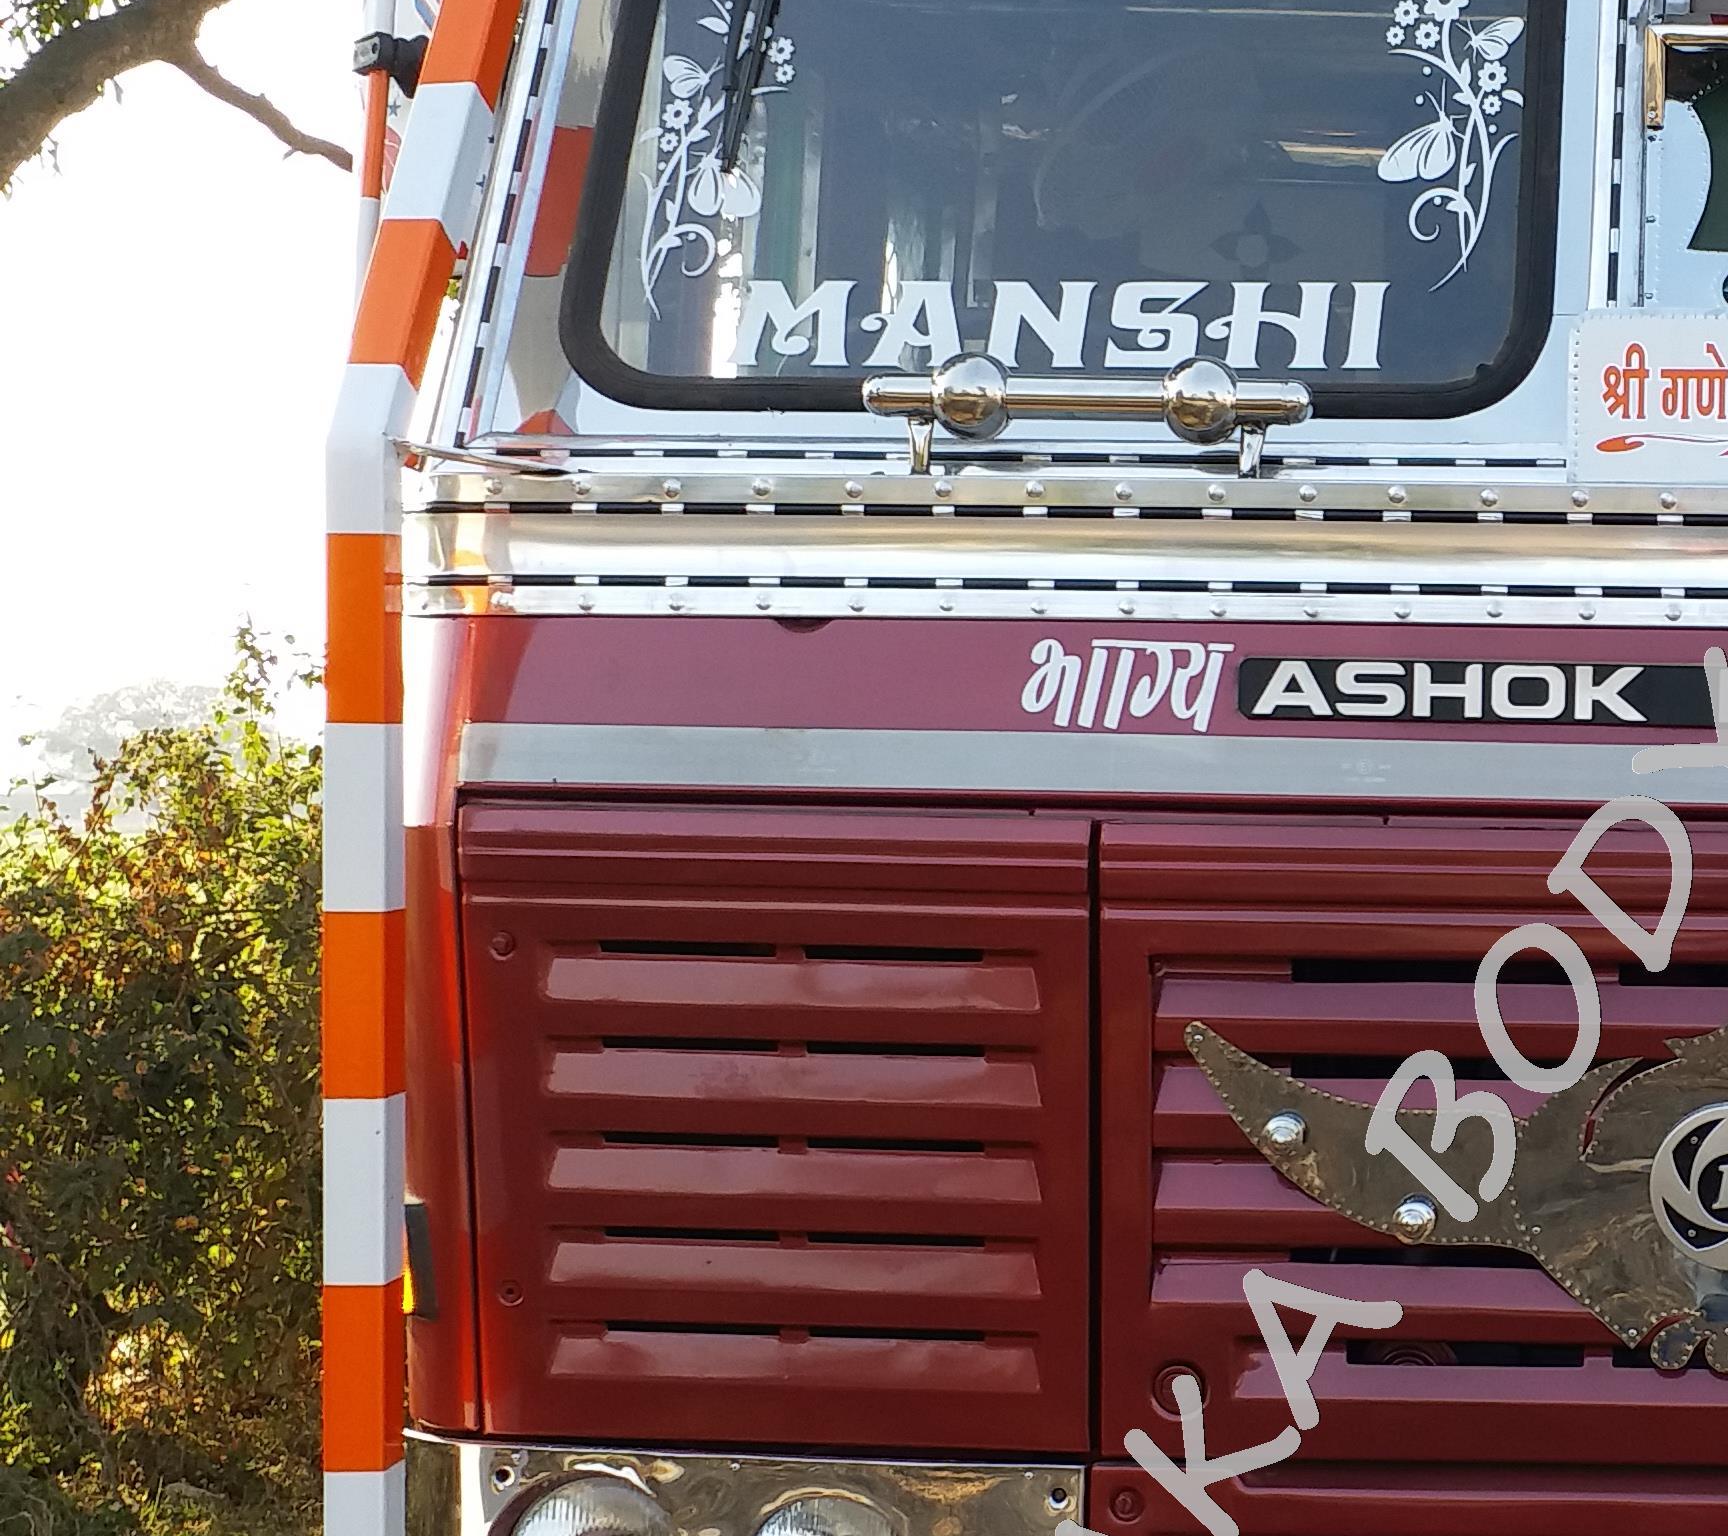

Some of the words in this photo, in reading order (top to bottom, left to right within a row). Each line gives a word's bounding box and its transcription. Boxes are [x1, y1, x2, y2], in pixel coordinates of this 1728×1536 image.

[734, 280, 1391, 369] MANSHI
[1603, 343, 1650, 419] श्री
[1022, 638, 1234, 731] भाग्य
[1253, 661, 1647, 722] ASHOK
